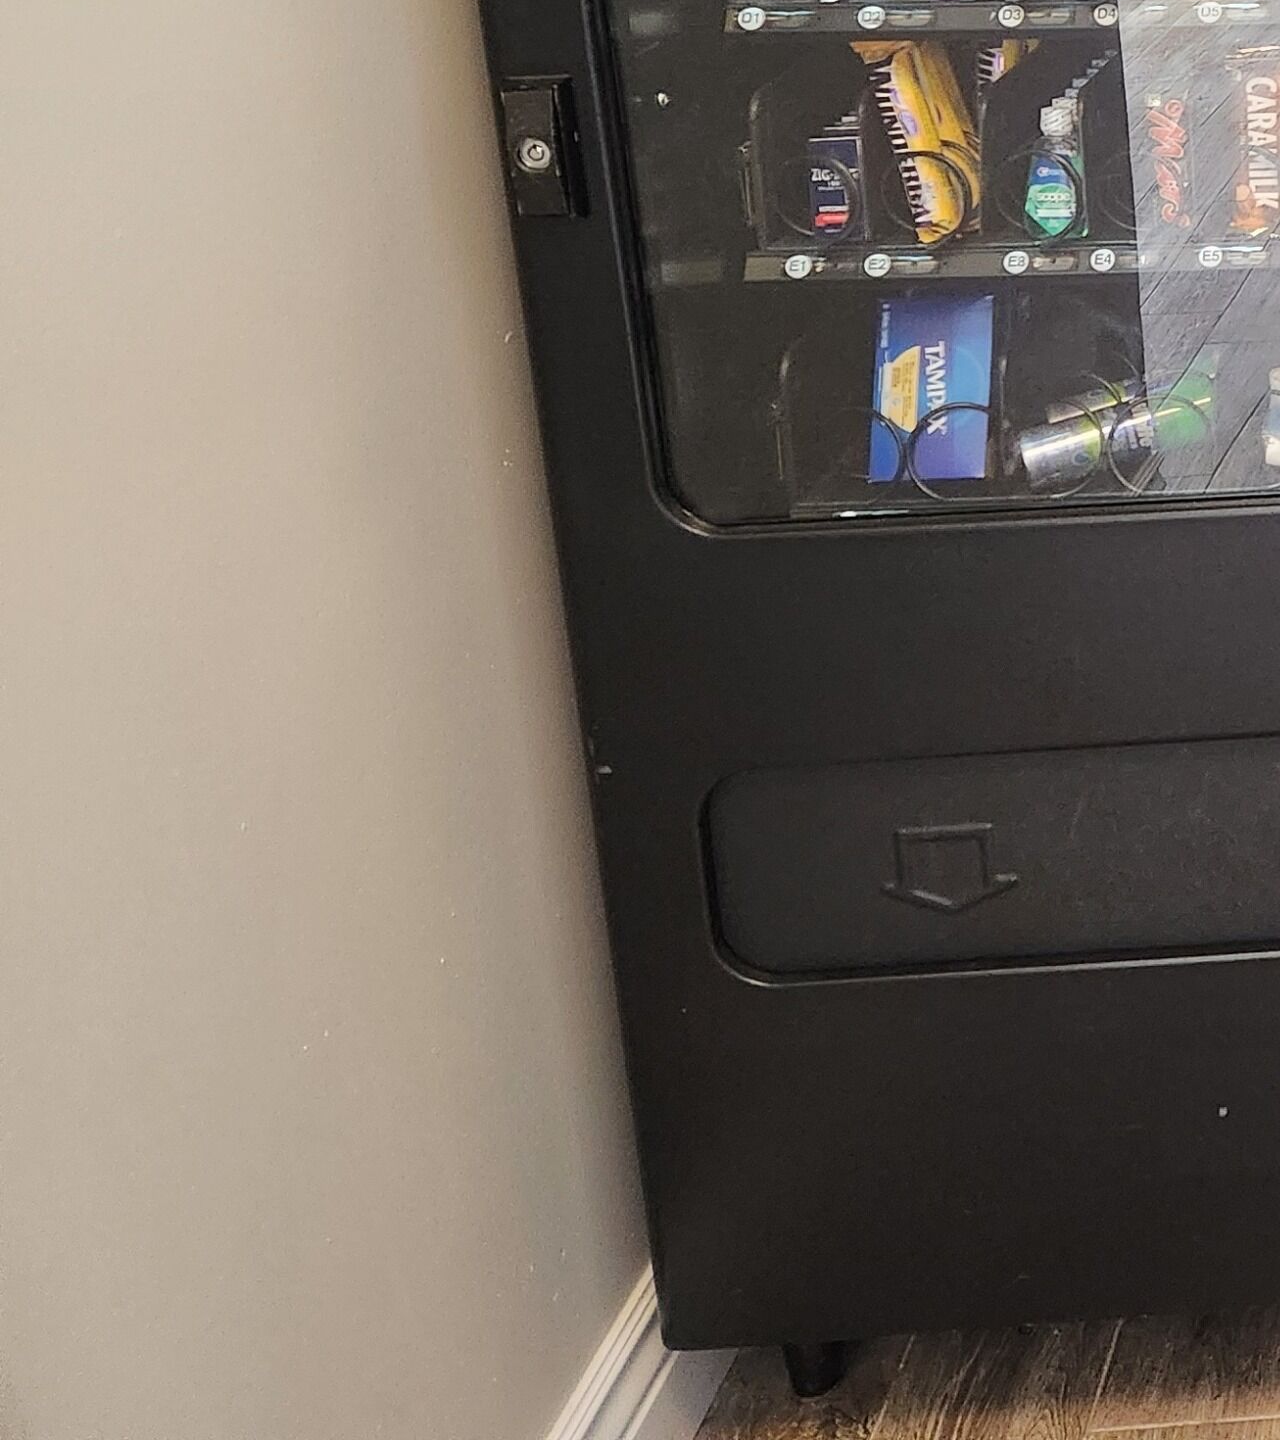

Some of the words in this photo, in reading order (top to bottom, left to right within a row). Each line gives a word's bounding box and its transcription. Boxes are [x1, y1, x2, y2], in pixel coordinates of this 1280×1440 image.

[861, 10, 883, 24] D2
[1002, 9, 1021, 23] D3
[1097, 8, 1116, 21] D4
[1200, 4, 1220, 19] D5
[741, 12, 761, 26] D1
[1243, 76, 1280, 210] CARAMILK
[1008, 256, 1027, 268] E3
[1094, 254, 1112, 266] E4
[1202, 250, 1220, 263] E5
[789, 259, 808, 272] E1
[867, 258, 888, 270] E2
